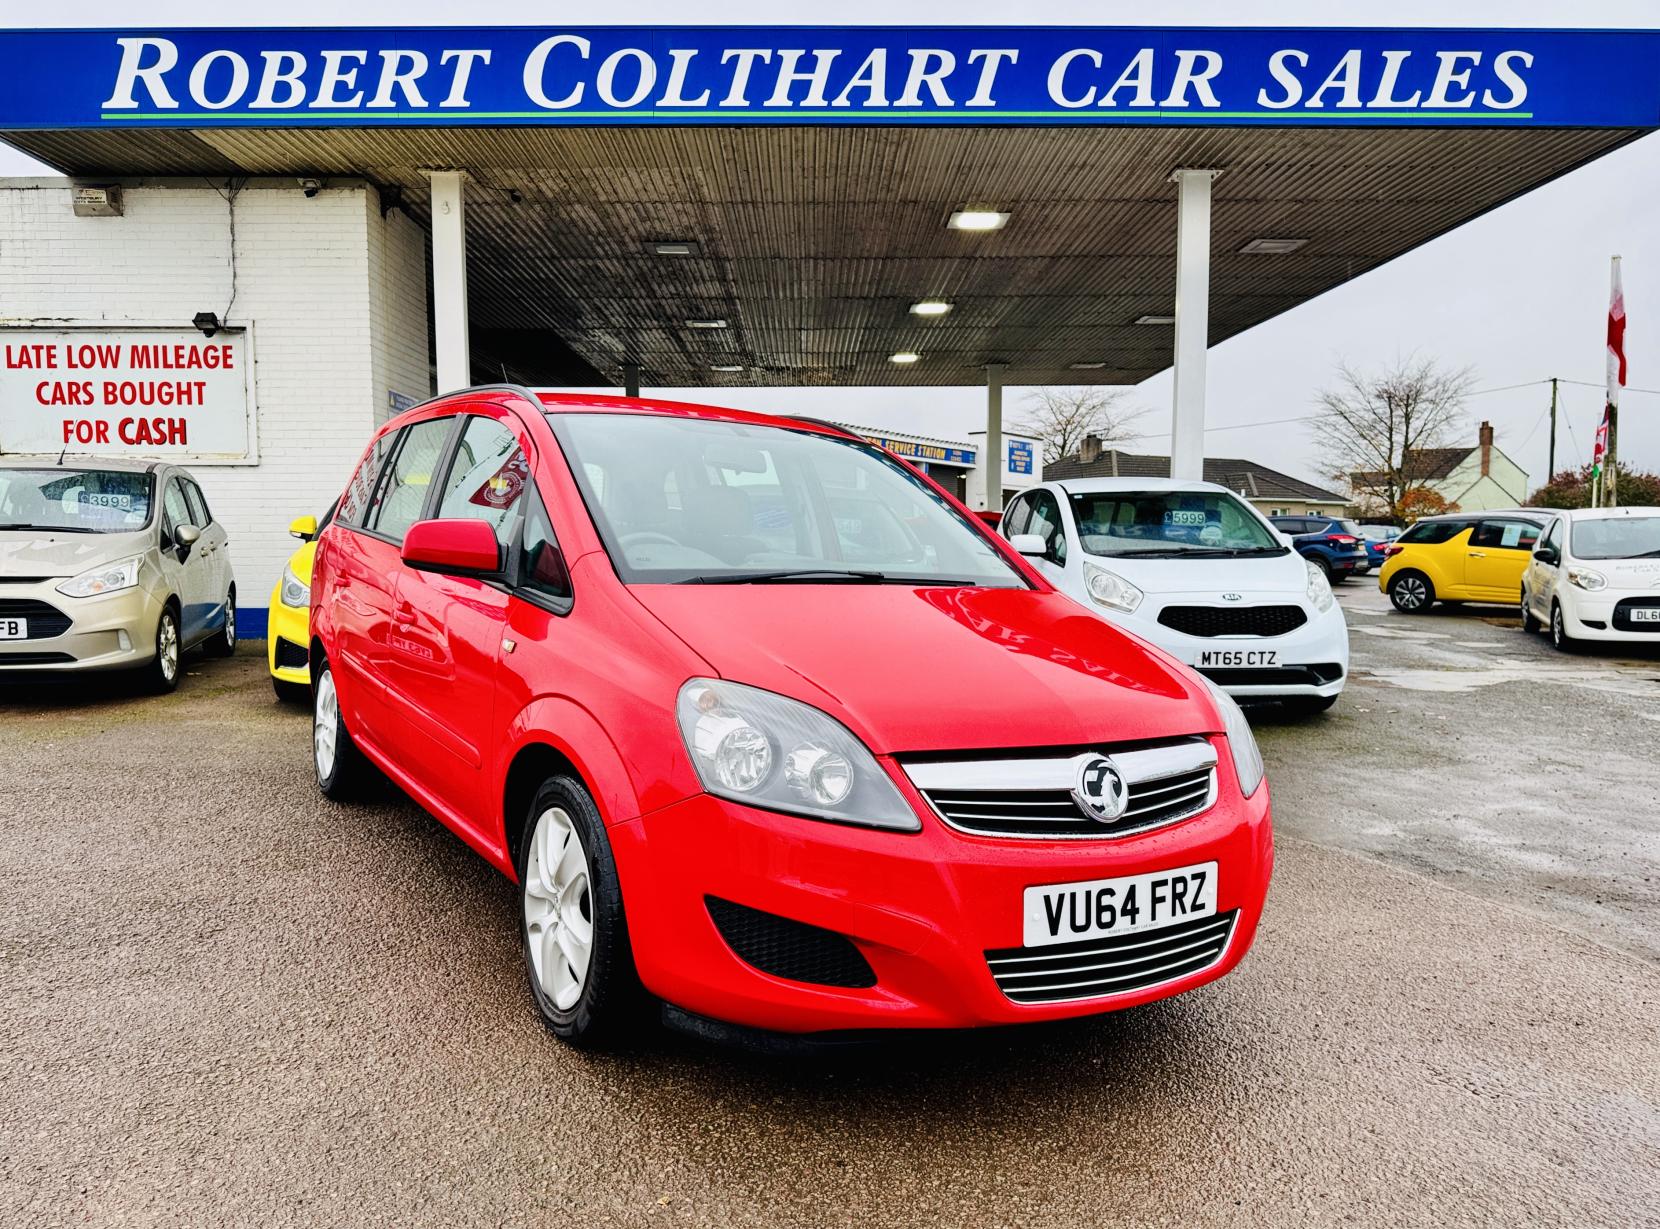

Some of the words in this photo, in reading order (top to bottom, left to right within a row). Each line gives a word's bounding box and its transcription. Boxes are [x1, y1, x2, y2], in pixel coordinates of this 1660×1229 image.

[102, 37, 492, 110] ROBERT
[522, 34, 1019, 110] COLTHART
[1046, 48, 1224, 109] CAR
[1256, 49, 1535, 110] SALES
[6, 345, 57, 370] LATE
[66, 345, 121, 370] LOW
[129, 345, 234, 370] MILEAGE
[36, 381, 95, 406] CARS
[103, 381, 207, 406] BOUGHT
[62, 419, 110, 444] FOR
[118, 417, 188, 446] CASH
[886, 440, 915, 456] SERVICE
[917, 444, 946, 460] STATION
[1164, 511, 1206, 524] £5999
[1636, 610, 1660, 620] DL6
[1201, 651, 1243, 666] MT65
[1247, 651, 1277, 665] CTZ
[1043, 884, 1140, 937] VU64
[1150, 871, 1207, 922] FRZ
